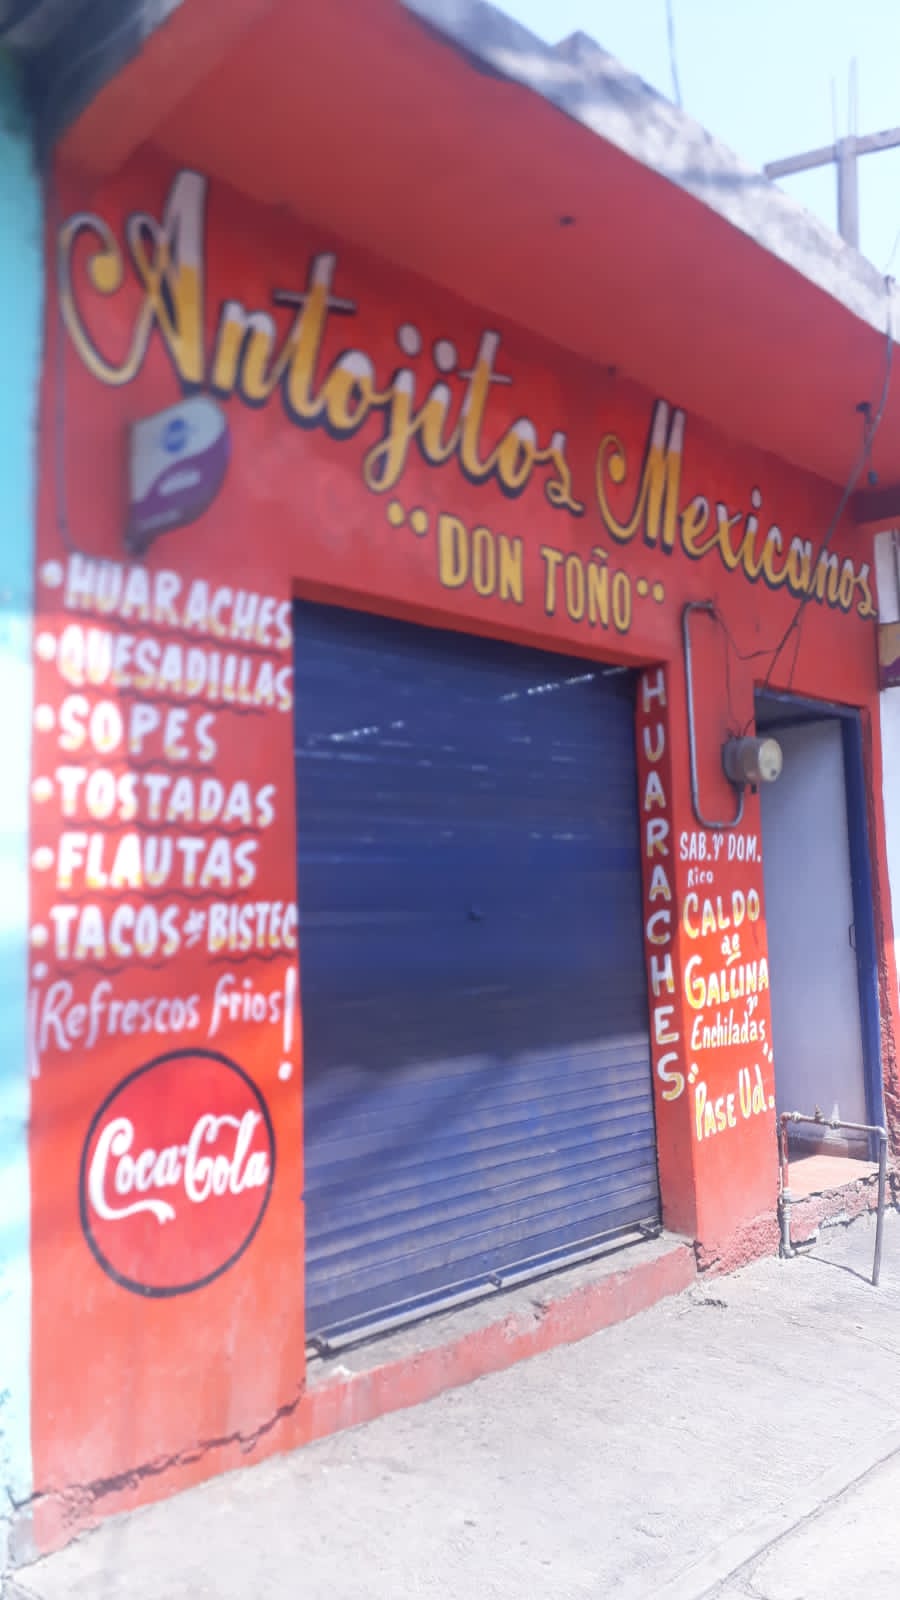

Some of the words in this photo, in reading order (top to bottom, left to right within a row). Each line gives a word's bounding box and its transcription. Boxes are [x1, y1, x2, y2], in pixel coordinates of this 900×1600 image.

[56, 168, 584, 516] Antojitos
[595, 400, 877, 620] Mexicanos
[65, 553, 293, 649] HUARACHES
[436, 513, 524, 605] DON
[540, 545, 632, 634] TOÑO
[59, 624, 293, 712] QUESADILLAS
[58, 694, 217, 762] SOPES
[56, 765, 276, 828] TOSTADAS
[57, 832, 258, 890] FLAUTAS
[687, 867, 713, 887] Rico
[728, 833, 761, 862] DOM.
[641, 668, 685, 1102] HUARACHES
[683, 888, 760, 939] CALDO
[50, 903, 179, 960] TACOS
[208, 902, 297, 951] BISTEC
[685, 954, 769, 1009] GALLINA
[691, 1009, 766, 1050] Enchiladas
[89, 1109, 269, 1224] Coca-Cola
